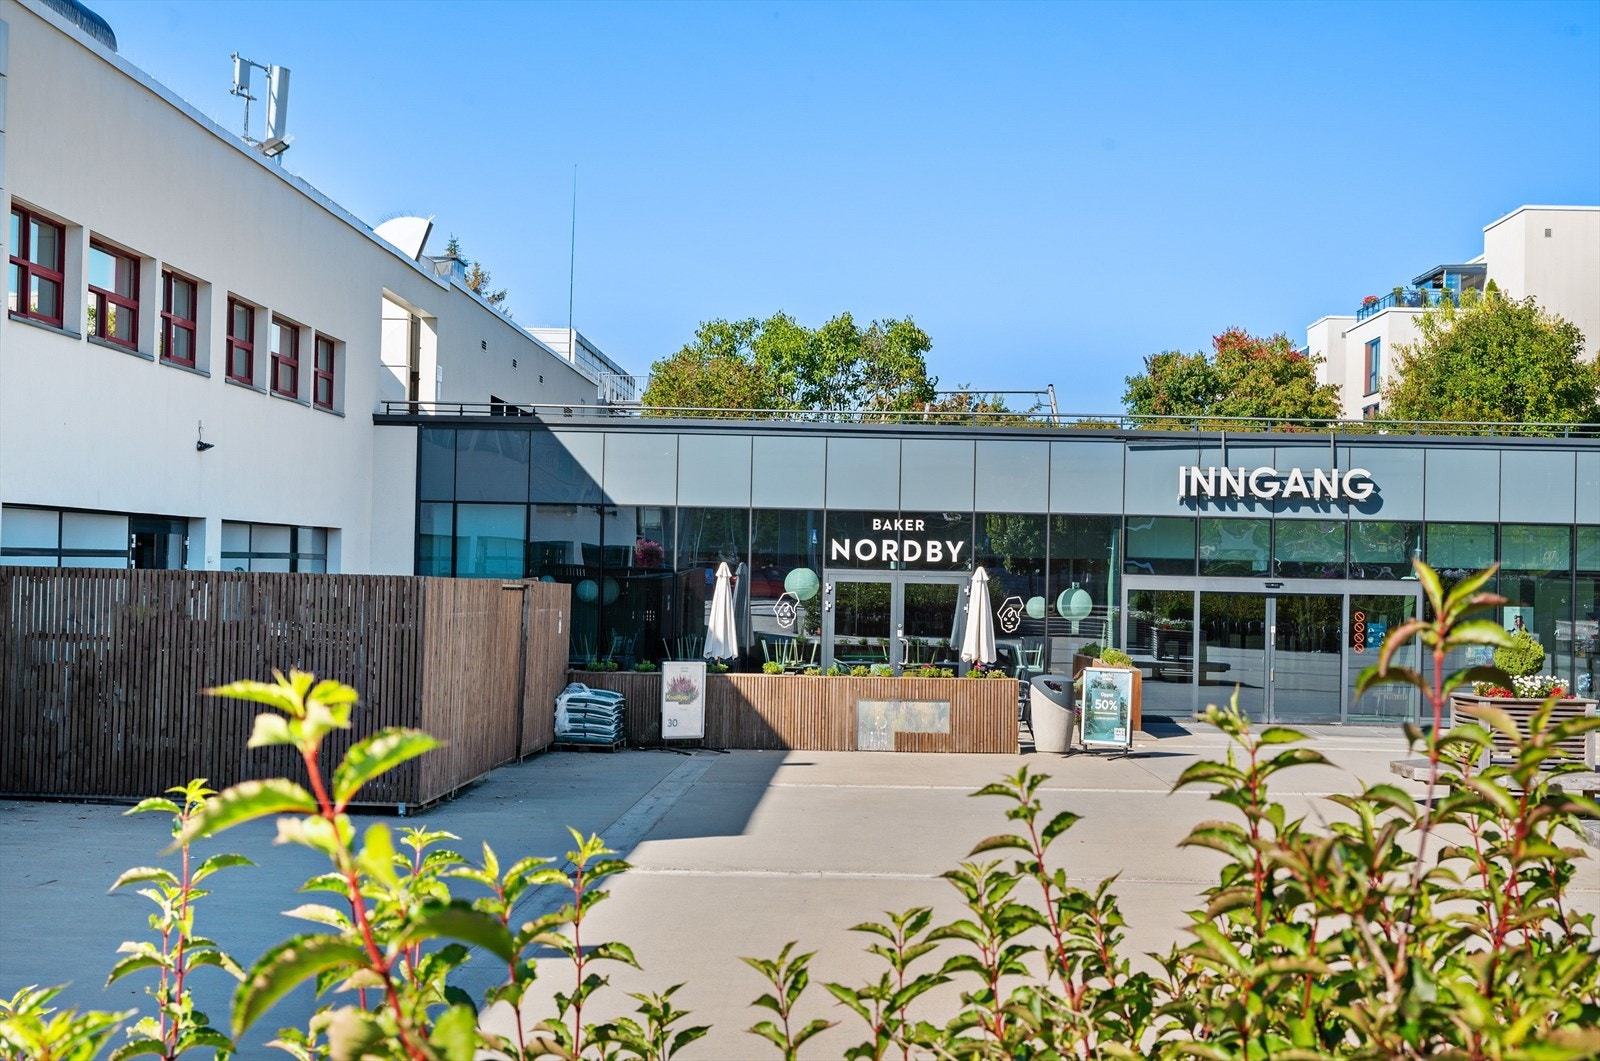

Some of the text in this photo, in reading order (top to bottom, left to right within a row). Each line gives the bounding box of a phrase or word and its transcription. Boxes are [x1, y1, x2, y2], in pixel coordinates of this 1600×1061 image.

[1179, 466, 1374, 499] INNGANG
[872, 519, 925, 531] BAKER
[831, 538, 965, 562] NORDBY
[1095, 700, 1117, 710] 50%
